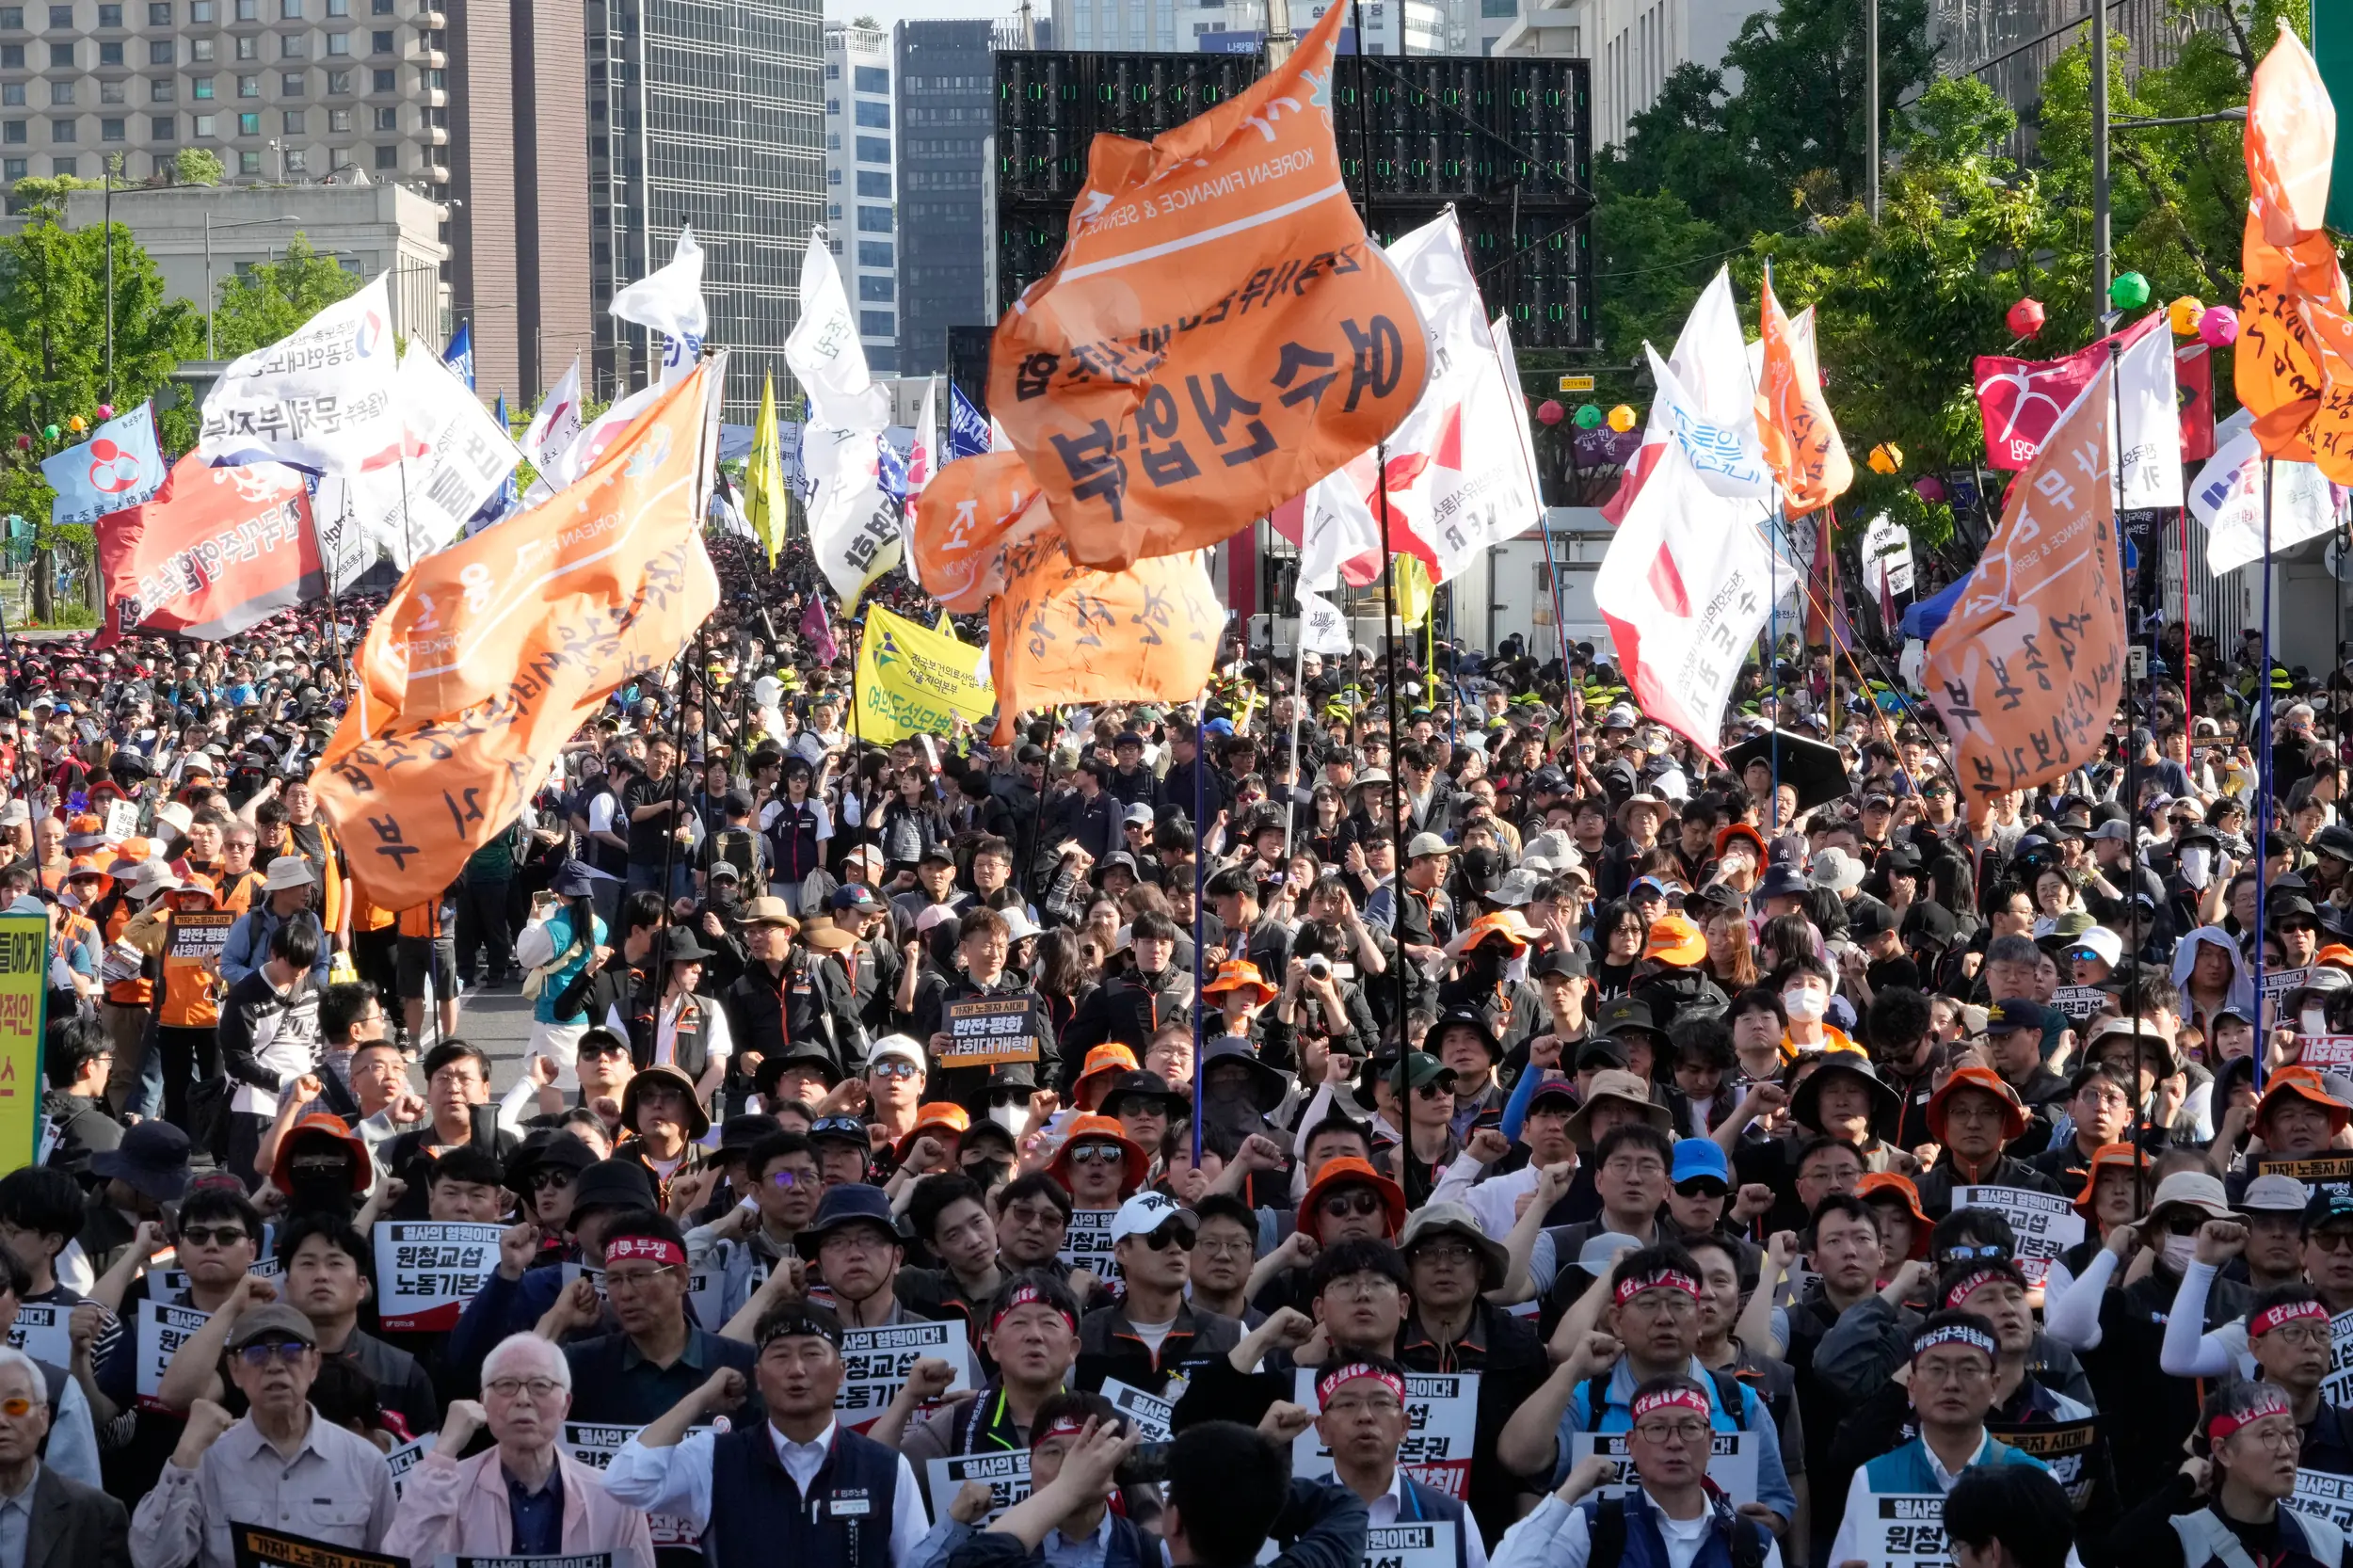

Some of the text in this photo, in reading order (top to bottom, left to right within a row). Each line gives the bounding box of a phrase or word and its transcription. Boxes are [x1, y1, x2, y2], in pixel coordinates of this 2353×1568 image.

[906, 667, 958, 696] 서울지역본부
[953, 1001, 1025, 1015] 가자! 노동자 시대!
[952, 1016, 1023, 1035] 반전·평화
[2297, 1161, 2336, 1176] 노동자
[1977, 1189, 2068, 1215] 열사의 염원이다!
[402, 1225, 442, 1241] 열사의
[633, 1239, 667, 1259] 투쟁
[875, 1327, 941, 1350] 염원이다!
[578, 1429, 622, 1448] 열사의
[962, 1457, 1013, 1479] 열사의
